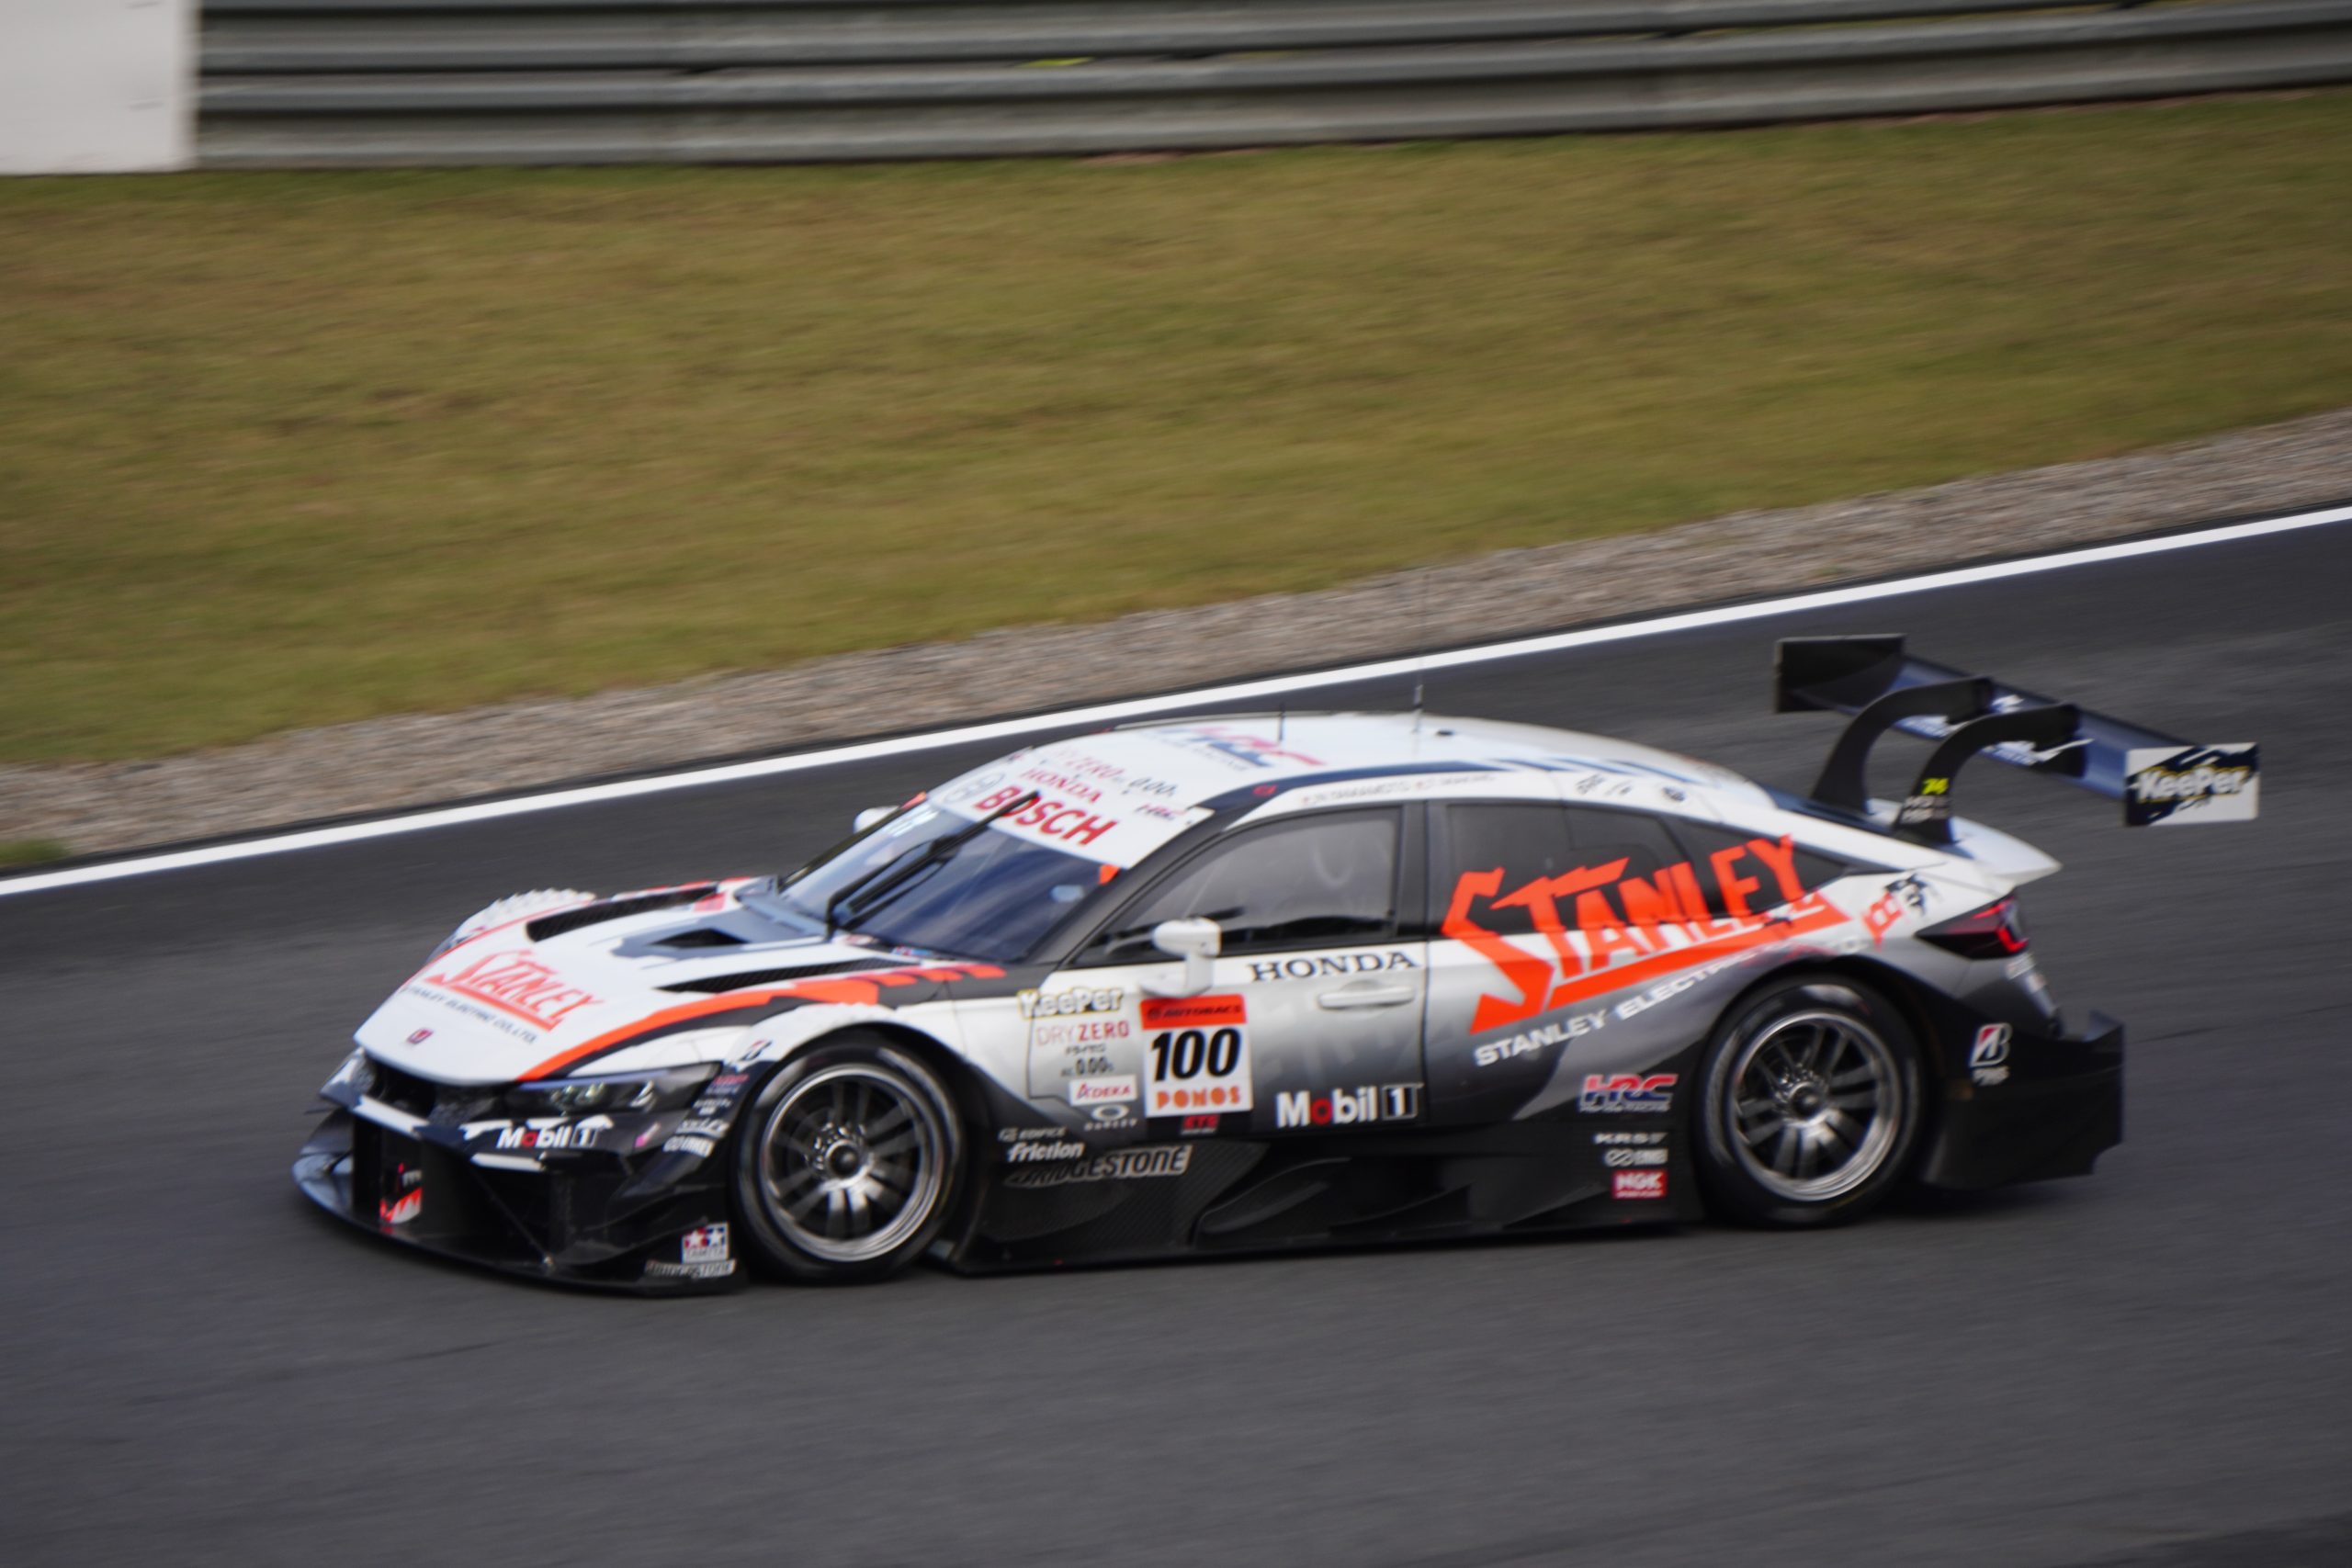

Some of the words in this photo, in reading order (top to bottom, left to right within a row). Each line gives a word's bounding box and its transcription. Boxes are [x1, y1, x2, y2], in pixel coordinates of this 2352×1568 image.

[1020, 767, 1102, 804] HONDA
[2136, 764, 2251, 804] KeePer
[972, 784, 1120, 846] BOSCH
[1441, 833, 1826, 1035] STANLEY
[1249, 952, 1418, 981] HONDA
[423, 949, 606, 1032] STANLEY
[1017, 987, 1123, 1020] KeePer
[1150, 1027, 1242, 1082] 100
[1475, 1010, 1606, 1067] STANLEY
[1275, 1086, 1378, 1129] Mobil
[1582, 1074, 1679, 1103] HRC
[496, 1125, 573, 1149] Mobil
[1008, 1142, 1086, 1162] friction
